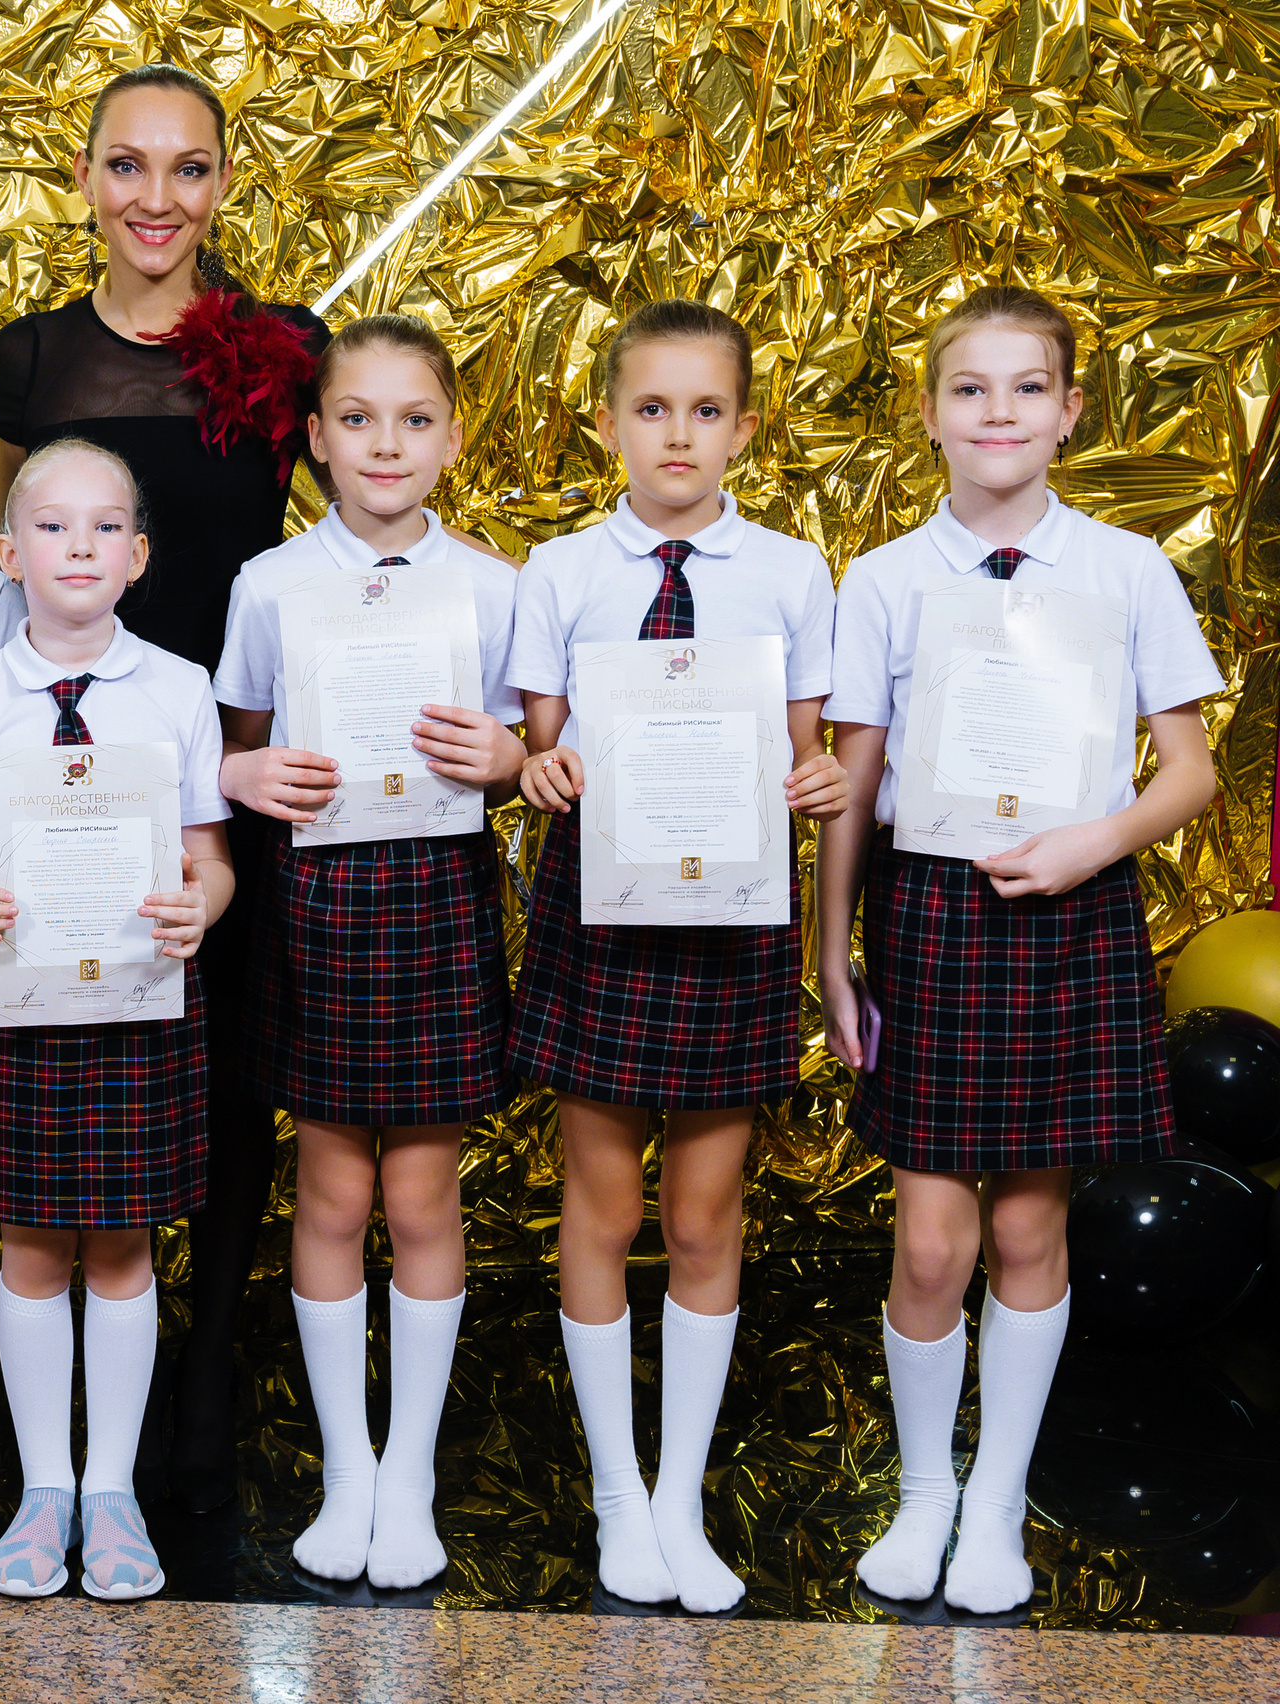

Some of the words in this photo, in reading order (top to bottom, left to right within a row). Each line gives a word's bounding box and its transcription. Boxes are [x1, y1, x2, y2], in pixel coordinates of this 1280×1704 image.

[351, 623, 408, 635] ПИСЬМО
[347, 642, 379, 651] Любимый
[984, 657, 1019, 667] Любимый
[652, 699, 712, 709] ПИСЬМО
[10, 792, 148, 806] БЛАГОДАРСТВЕННОЕ
[50, 805, 108, 816] ПИСЬМО
